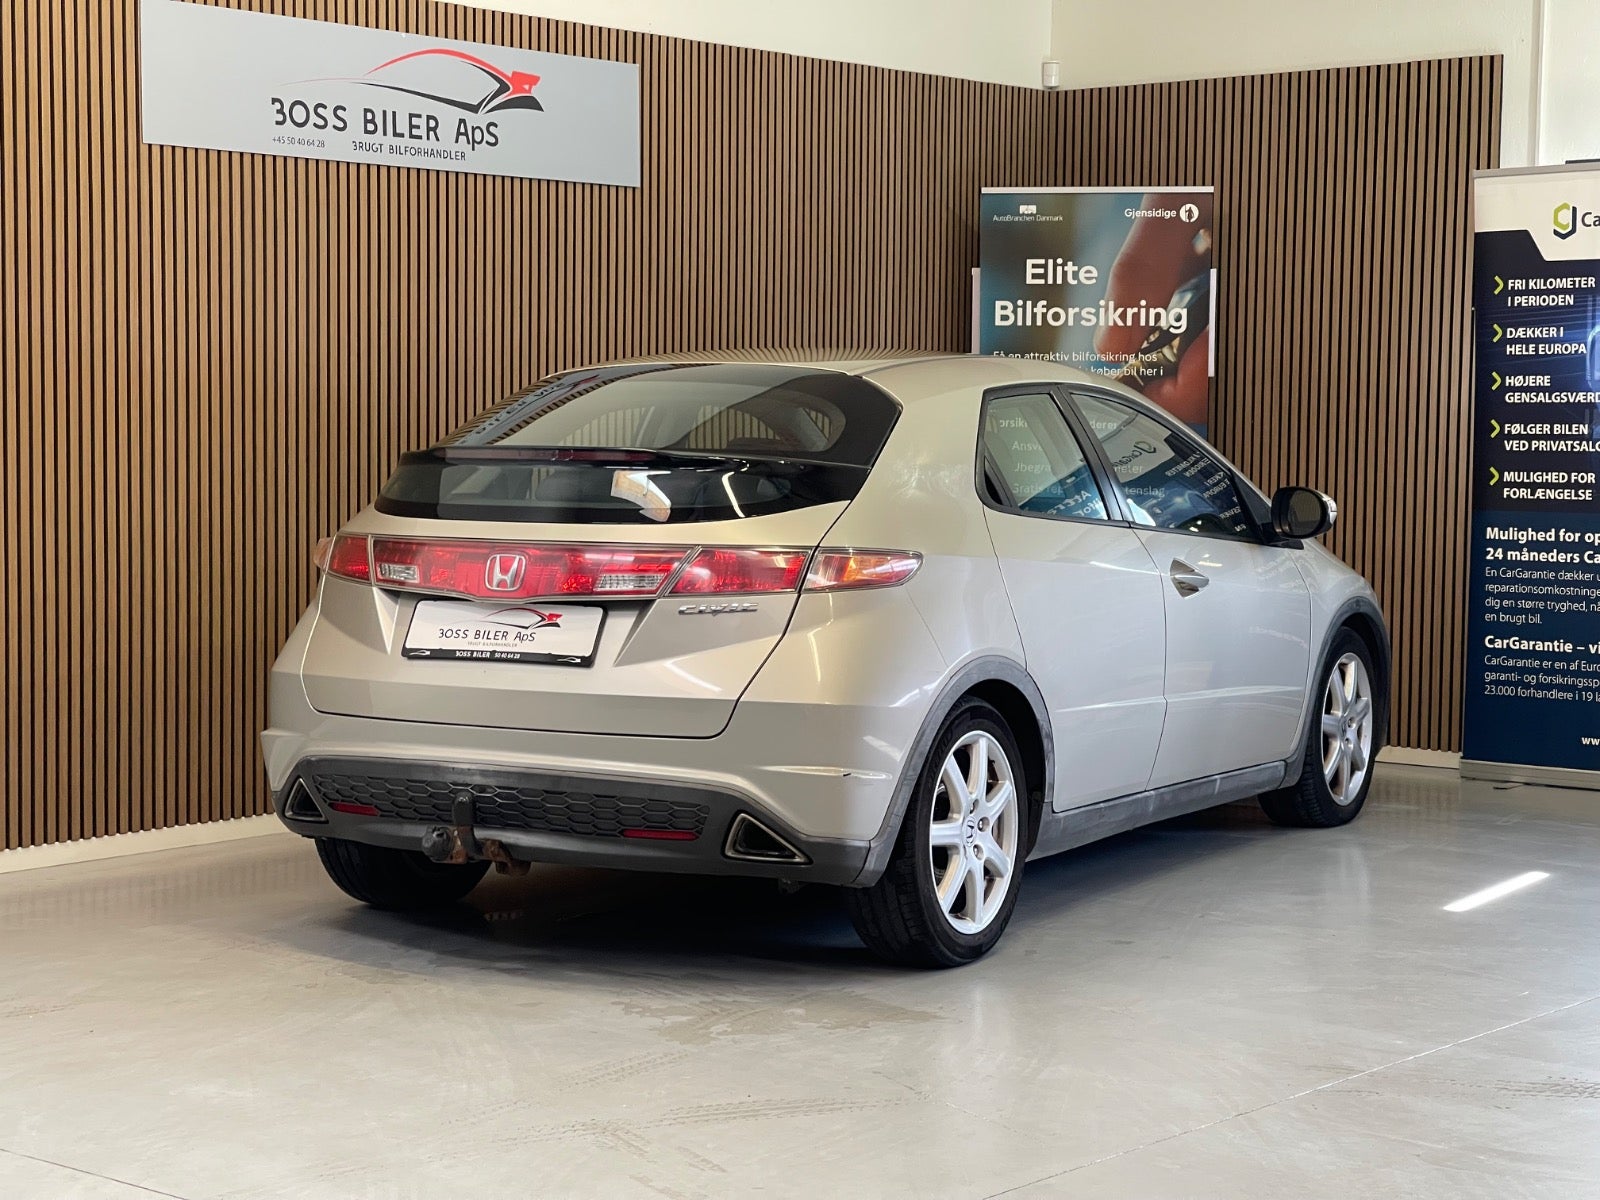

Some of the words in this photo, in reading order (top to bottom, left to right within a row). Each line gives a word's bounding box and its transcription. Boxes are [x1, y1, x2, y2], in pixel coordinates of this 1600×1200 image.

[363, 107, 440, 142] BILER
[454, 118, 499, 151] ApS
[272, 136, 285, 144] +45
[287, 136, 295, 145] 50
[297, 138, 305, 146] 40
[306, 139, 315, 147] 64
[316, 139, 325, 148] 28
[388, 144, 466, 161] BILFORHANDLER
[1036, 214, 1064, 222] Danmark
[1124, 208, 1177, 219] Gjensidige
[1025, 257, 1098, 285] Elite
[1507, 279, 1526, 290] FRI
[1528, 277, 1596, 290] KILOMETER
[1507, 296, 1511, 307] I
[1514, 294, 1574, 307] PERIODEN
[994, 299, 1189, 334] Bilforsikring
[1506, 327, 1557, 339] DÆKKER
[1559, 326, 1564, 338] I
[1506, 343, 1536, 355] HELE
[1538, 343, 1587, 355] EUROPA
[1024, 351, 1069, 361] attraktiv
[1072, 351, 1136, 363] bilforsikring
[1138, 351, 1158, 361] hos
[1124, 366, 1137, 376] bil
[1140, 366, 1158, 376] her
[1160, 366, 1164, 376] i
[1505, 375, 1551, 387] HØJERE
[1504, 424, 1551, 435] FØLGER
[1553, 424, 1588, 435] BILEN
[1503, 440, 1529, 451] VED
[1503, 471, 1568, 483] MULIGHED
[1570, 472, 1596, 484] FOR
[1503, 488, 1593, 500] FORLÆNGELSE
[1485, 526, 1555, 544] Mulighed
[1558, 528, 1581, 543] for
[1485, 547, 1504, 560] 24
[1507, 547, 1580, 563] måneders
[1485, 566, 1498, 577] En
[1500, 567, 1556, 580] CarGarantie
[1558, 569, 1594, 581] dækker
[1484, 597, 1501, 609] dig
[1502, 598, 1515, 608] en
[1517, 599, 1545, 609] større
[1547, 600, 1588, 613] tryghed,
[1484, 613, 1497, 622] en
[1499, 612, 1526, 625] brugt
[1528, 613, 1543, 624] bil.
[473, 629, 509, 641] BILER
[514, 631, 536, 644] ApS
[1484, 635, 1574, 653] CarGarantie
[472, 651, 490, 659] BILER
[1484, 654, 1541, 668] CarGarantie
[1543, 660, 1553, 669] er
[1554, 660, 1567, 670] en
[1569, 659, 1580, 671] af
[1484, 671, 1522, 682] garanti-
[1524, 674, 1537, 685] og
[1484, 684, 1516, 696] 23.000
[1518, 686, 1574, 701] forhandlere
[1582, 691, 1594, 702] 19
